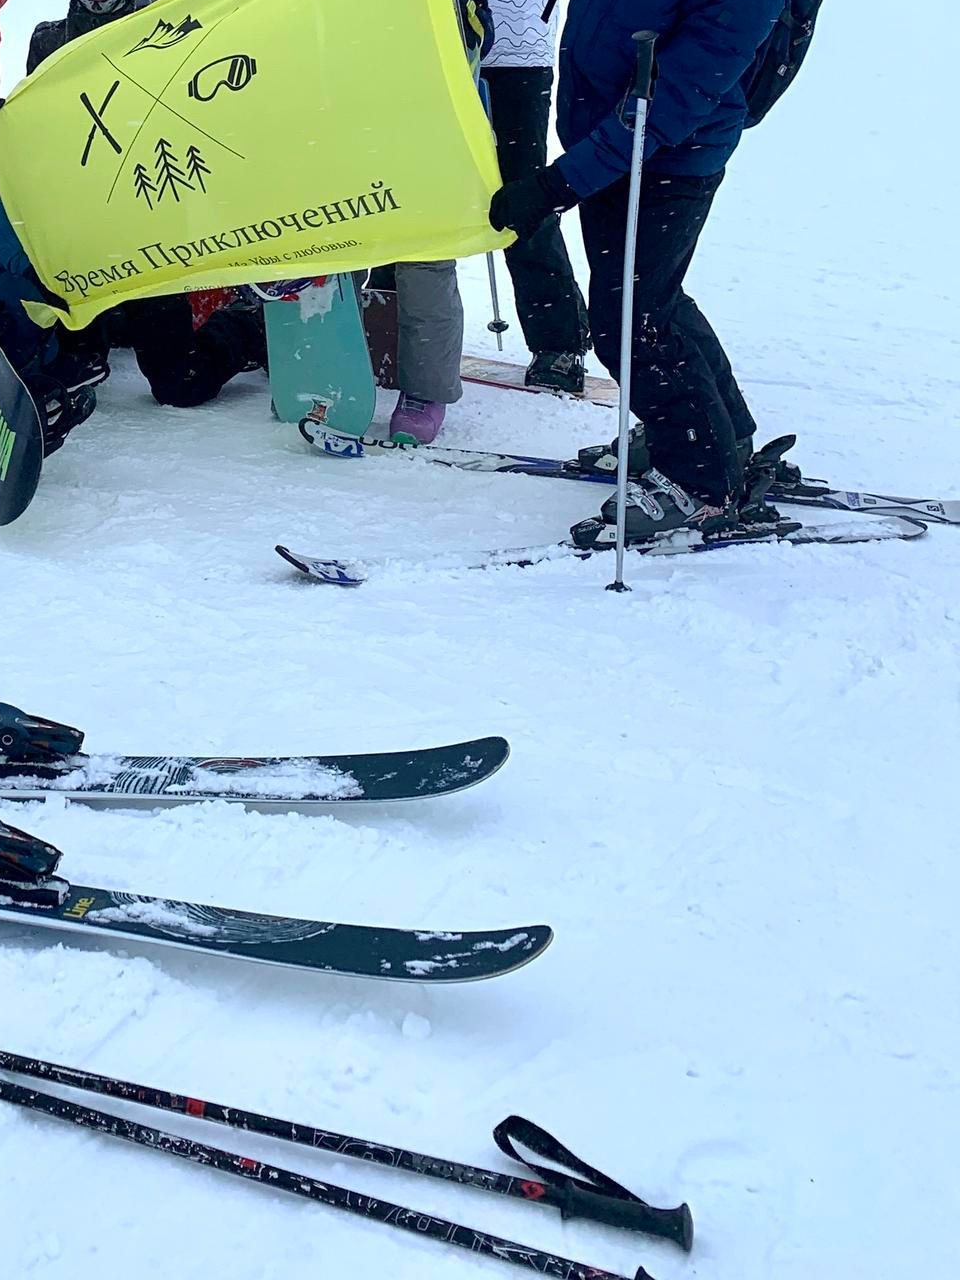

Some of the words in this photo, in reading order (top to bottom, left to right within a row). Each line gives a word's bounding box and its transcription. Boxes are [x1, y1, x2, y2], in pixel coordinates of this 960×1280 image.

[53, 259, 144, 297] Время
[138, 180, 401, 267] Приключений
[291, 239, 363, 260] любовью.
